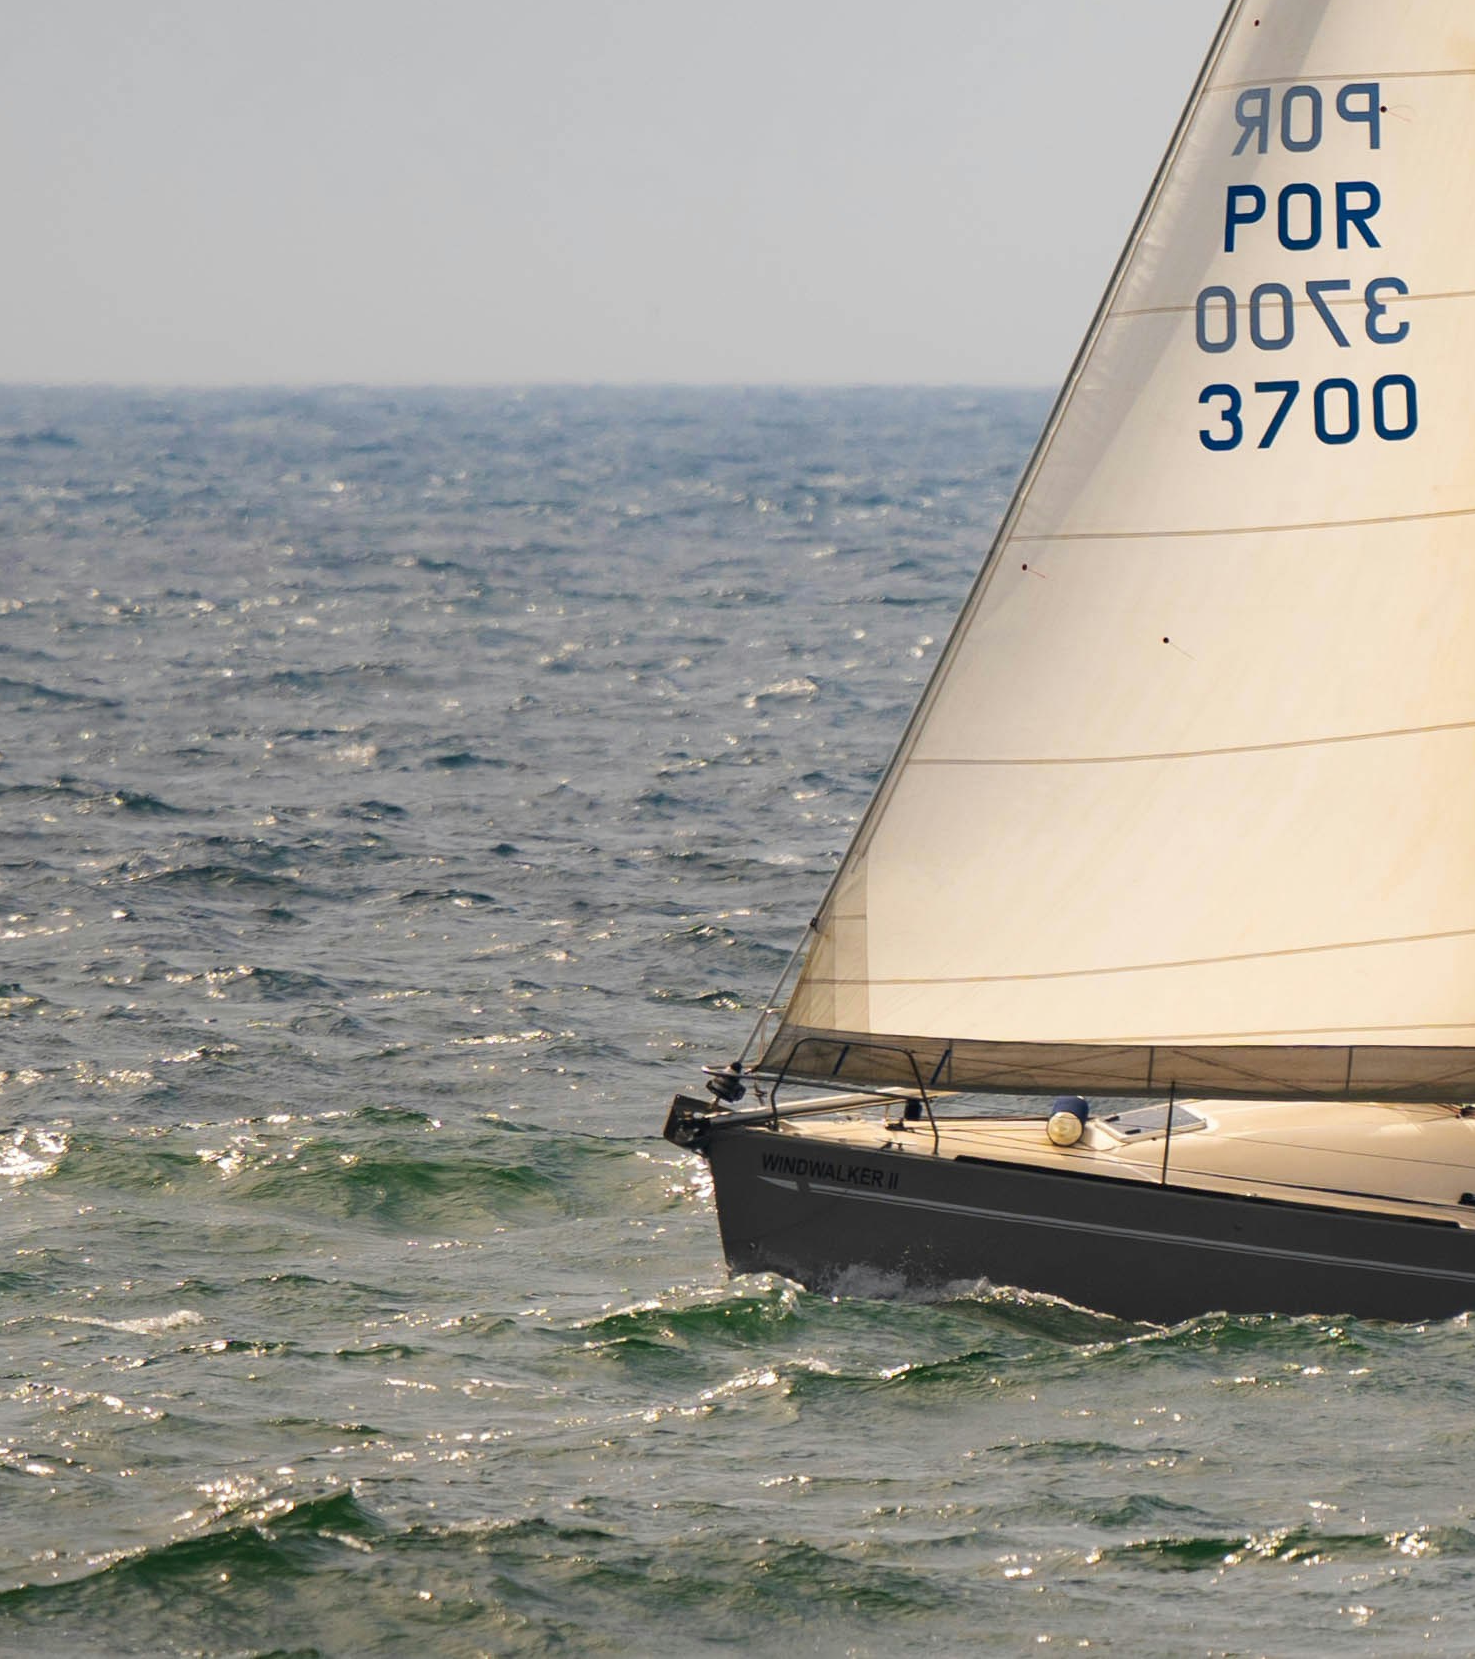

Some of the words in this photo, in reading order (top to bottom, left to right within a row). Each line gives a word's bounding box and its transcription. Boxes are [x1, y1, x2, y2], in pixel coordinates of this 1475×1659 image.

[1224, 181, 1382, 253] POR
[1198, 374, 1418, 451] 3700
[762, 1153, 884, 1188] WINDWALKER
